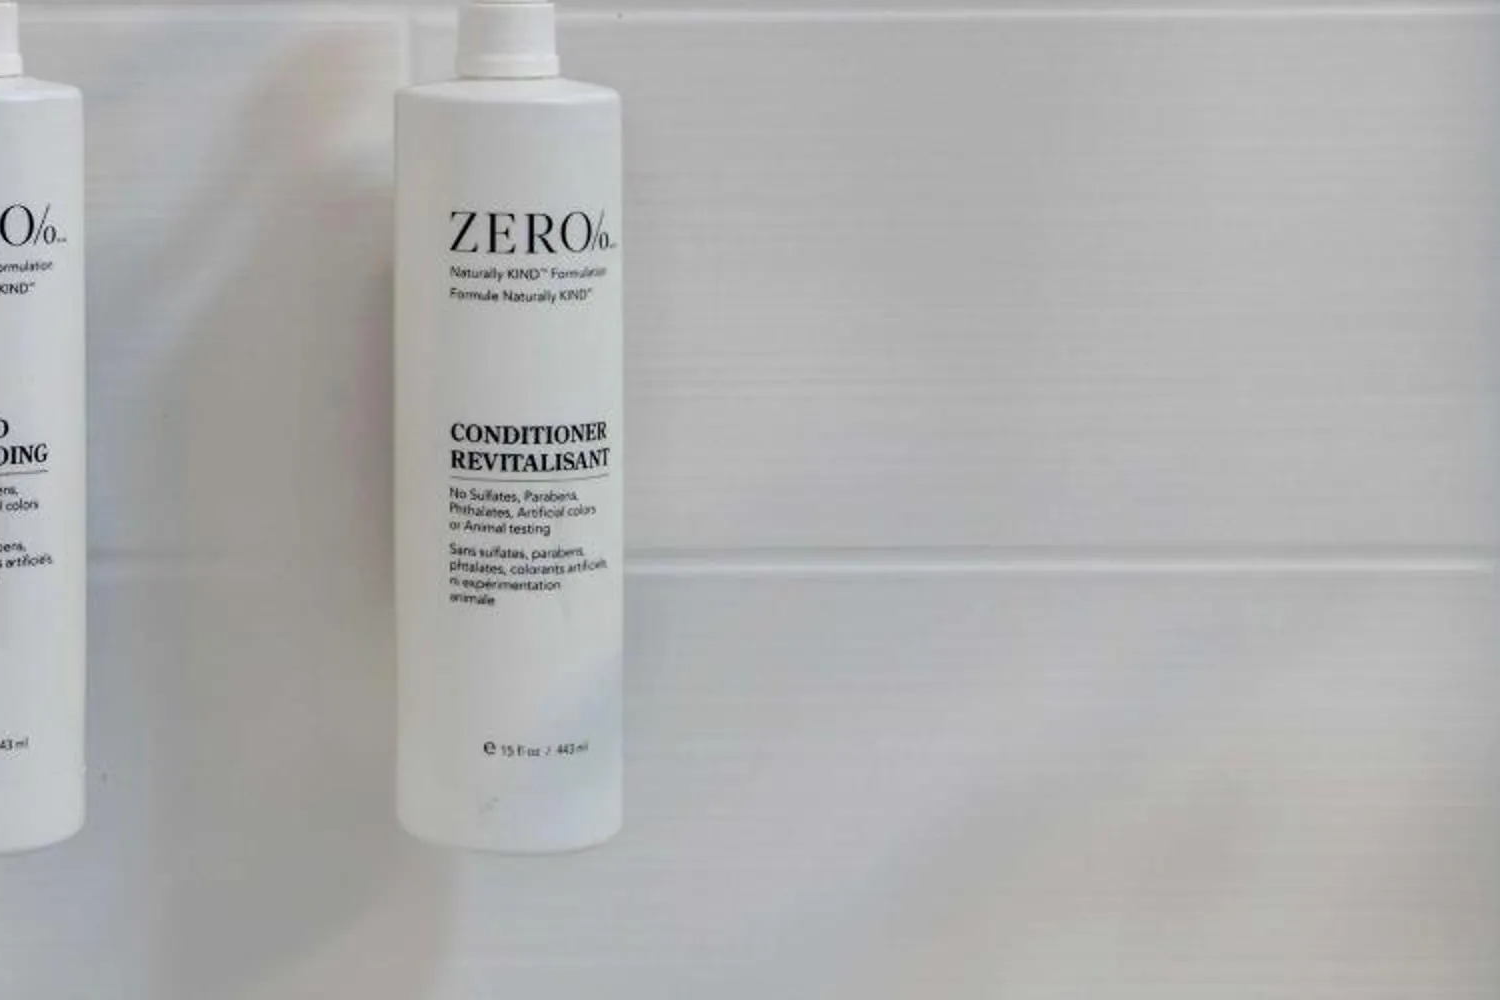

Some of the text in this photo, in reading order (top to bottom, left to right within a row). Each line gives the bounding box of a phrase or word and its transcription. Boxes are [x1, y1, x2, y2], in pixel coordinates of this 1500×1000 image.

[450, 266, 504, 281] Naturally
[449, 287, 499, 302] Formule
[503, 290, 556, 304] Naturally
[451, 421, 607, 445] CONDITIONER
[451, 448, 610, 472] REVITALISANT
[449, 487, 466, 499] No
[464, 520, 506, 534] Animal
[509, 524, 551, 536] testing
[449, 543, 476, 556] Sans
